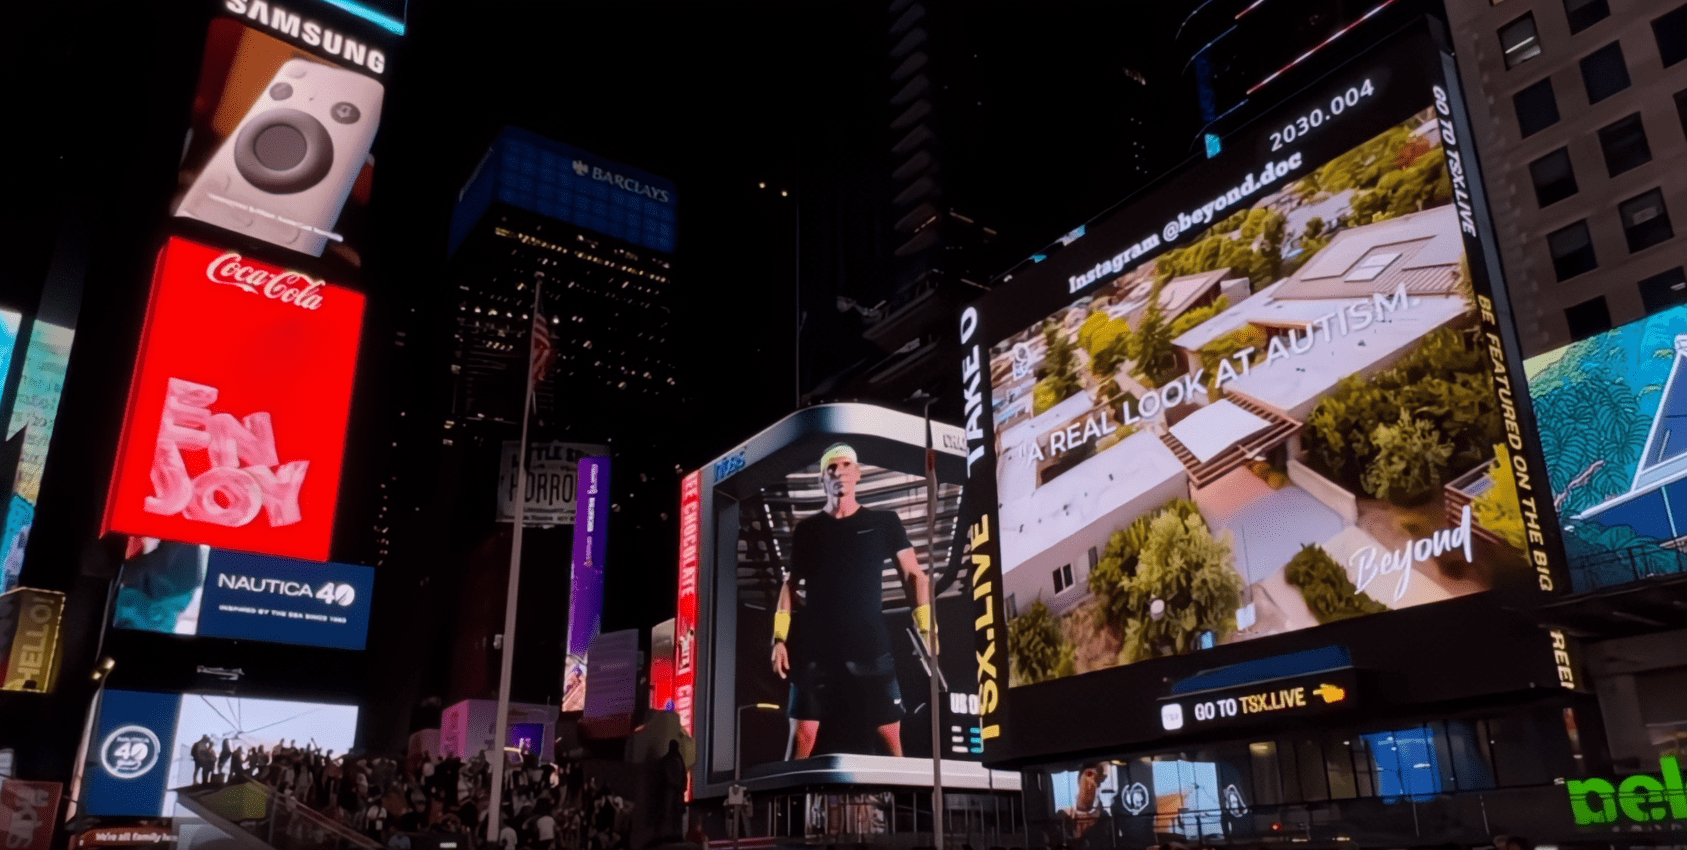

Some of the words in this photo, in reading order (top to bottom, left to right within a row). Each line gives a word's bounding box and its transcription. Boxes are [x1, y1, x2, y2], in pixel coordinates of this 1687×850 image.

[225, 0, 385, 74] SAMSUNG
[1269, 78, 1374, 152] 2030.004
[1433, 85, 1450, 116] GO
[1439, 119, 1456, 146] TO
[592, 166, 670, 203] BARCLAYS
[1446, 149, 1477, 238] TSX.LIVE
[1068, 233, 1161, 294] Instagram
[1162, 151, 1303, 243] @beyond.doc
[206, 252, 326, 310] Coca-Cola
[1477, 294, 1496, 326] BE
[1050, 411, 1117, 457] REAL
[1123, 368, 1207, 426] LOOK
[1215, 346, 1255, 389] AT
[1266, 281, 1421, 367] AUTISM.
[1486, 332, 1522, 450] FEATURED
[962, 344, 985, 479] TAKE
[1513, 455, 1532, 491] ON
[681, 501, 698, 598] CHOCOLATE
[1348, 504, 1473, 603] Beyond
[1522, 497, 1544, 546] THE
[218, 573, 313, 598] NAUTICA
[1532, 549, 1554, 592] BIG
[970, 513, 1000, 753] TSX.LIVE
[1194, 701, 1216, 721] GO
[1216, 698, 1238, 718] TO
[1238, 686, 1307, 715] TSX.LIVE
